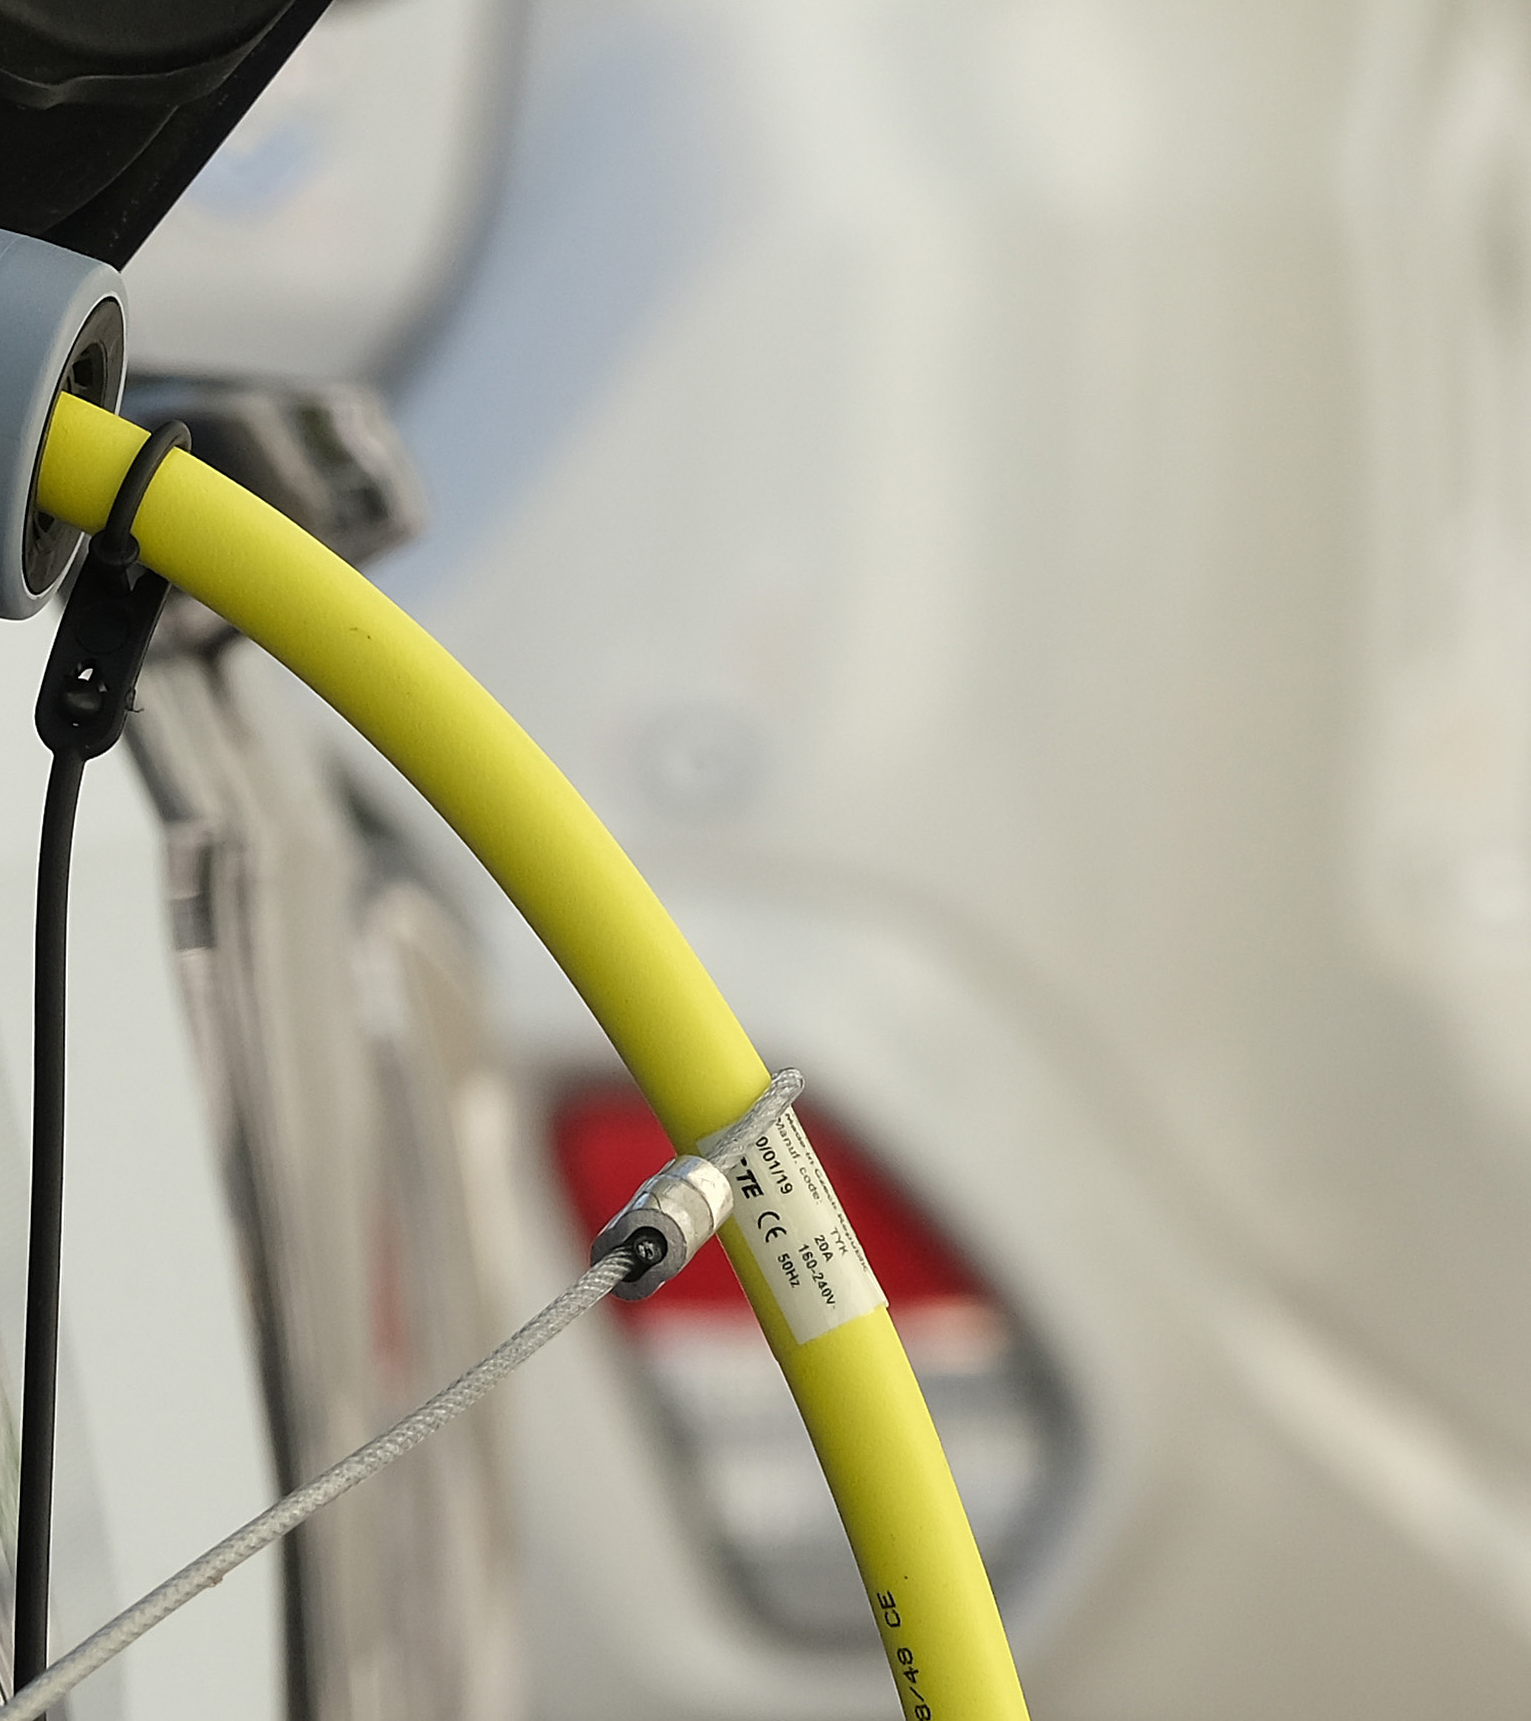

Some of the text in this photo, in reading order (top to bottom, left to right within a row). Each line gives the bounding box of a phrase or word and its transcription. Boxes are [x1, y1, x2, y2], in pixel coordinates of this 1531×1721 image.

[814, 1234, 834, 1263] 20A
[830, 1226, 849, 1256] TYK
[777, 1252, 800, 1289] 50Hz
